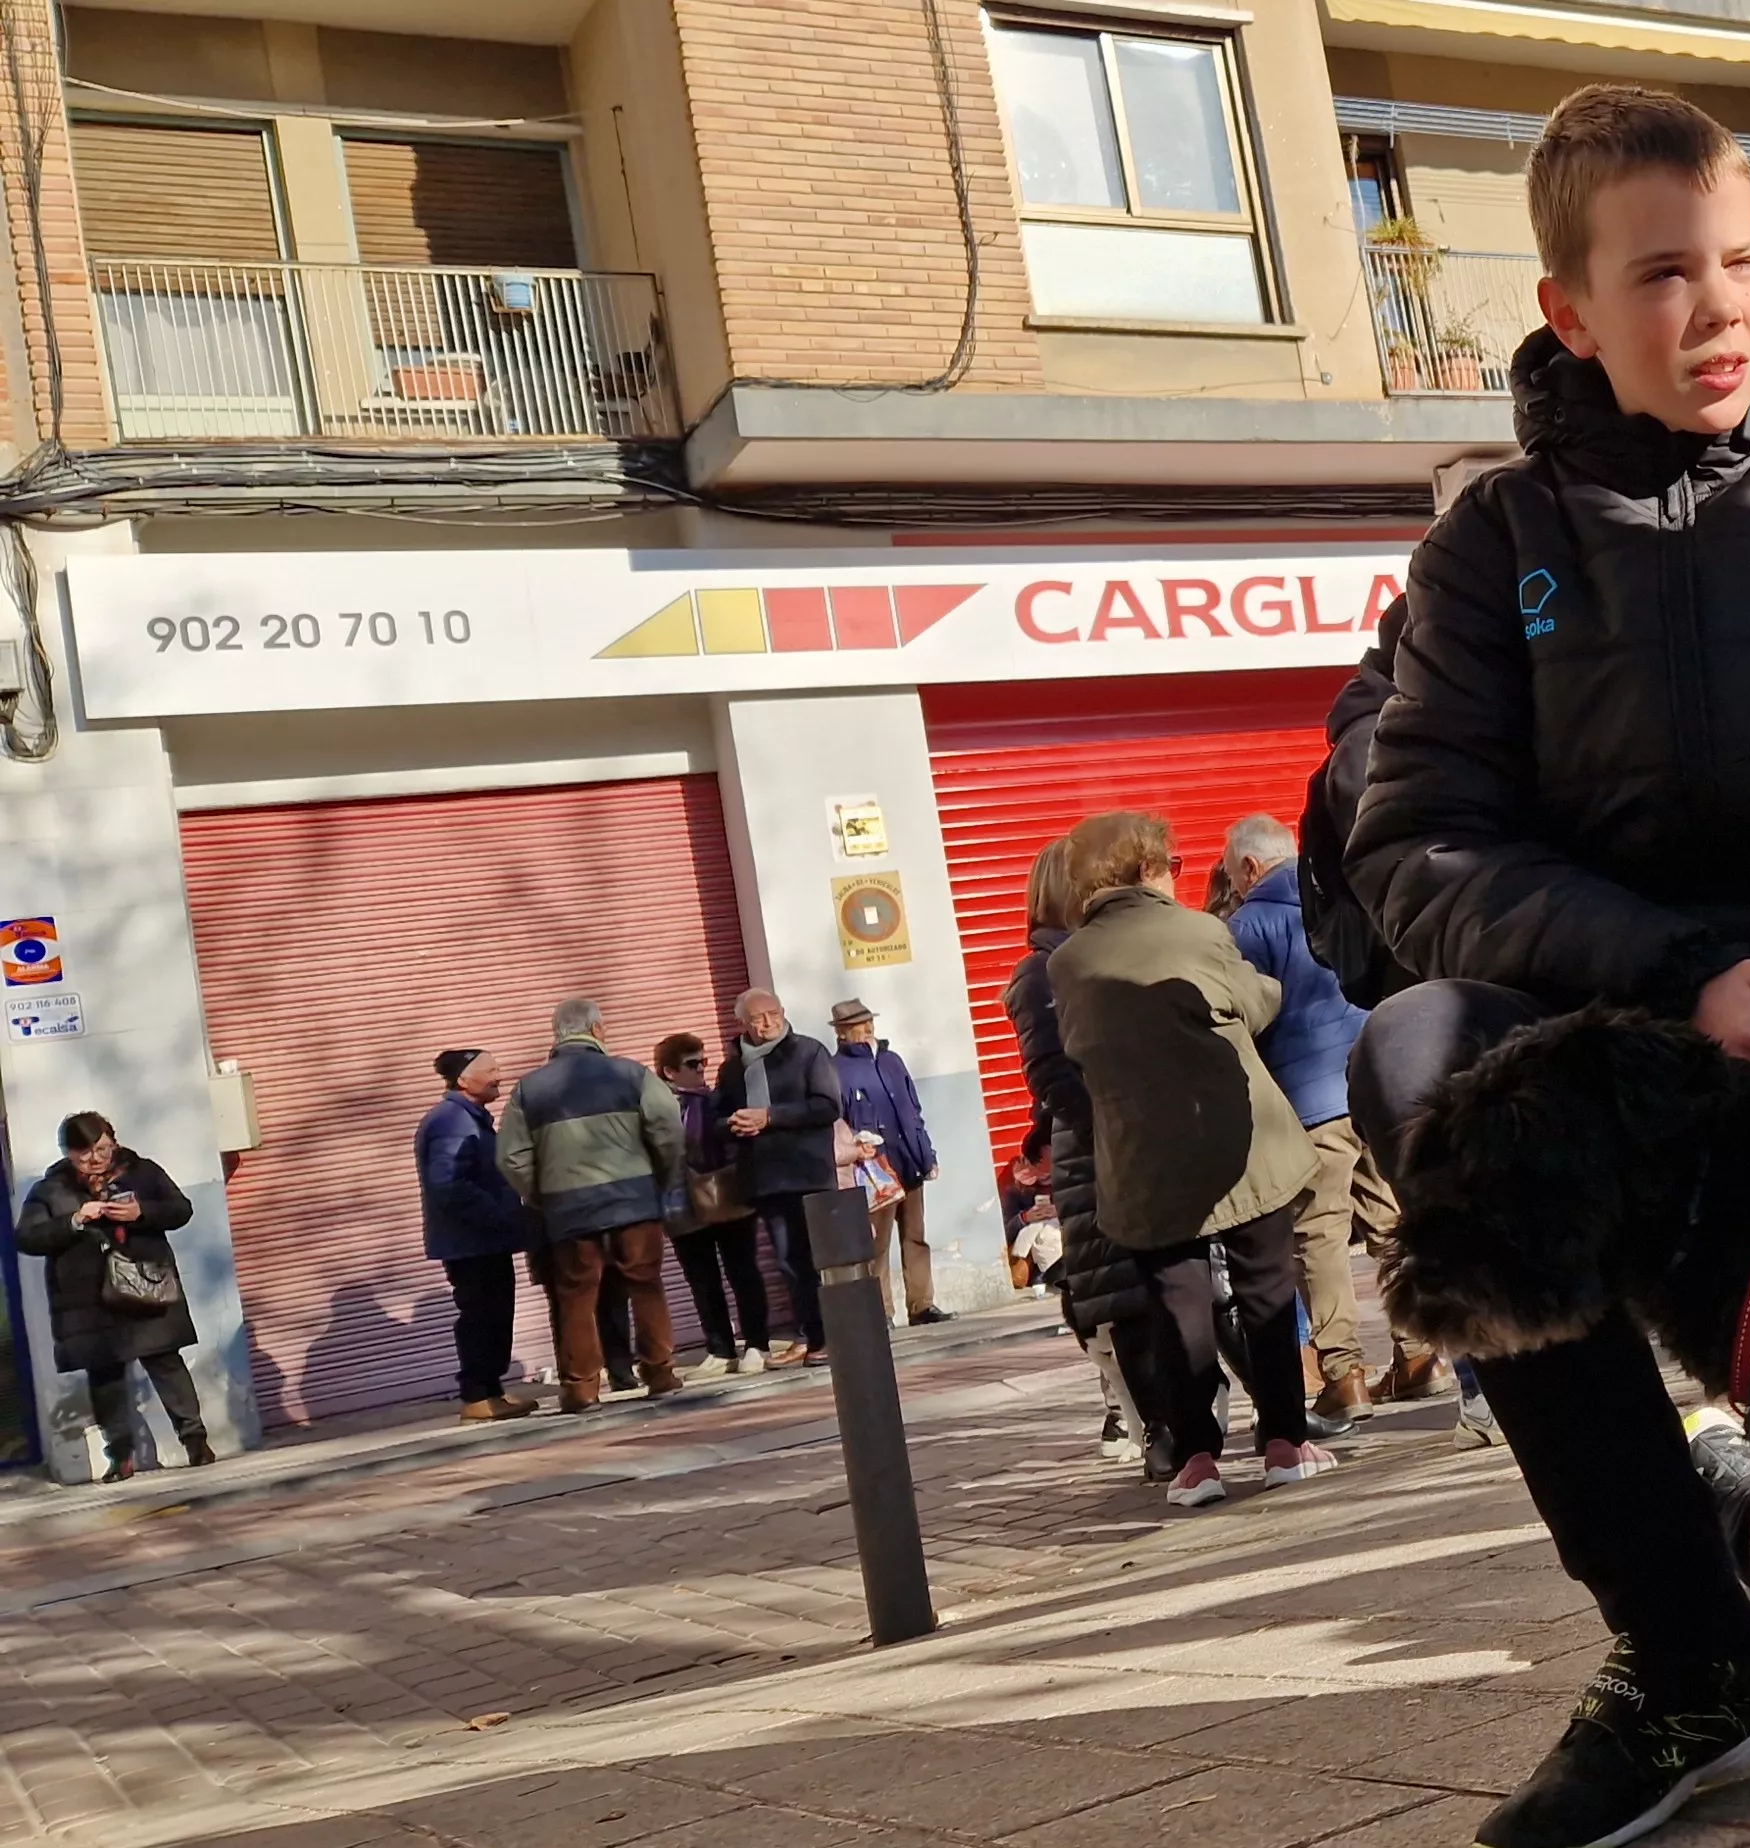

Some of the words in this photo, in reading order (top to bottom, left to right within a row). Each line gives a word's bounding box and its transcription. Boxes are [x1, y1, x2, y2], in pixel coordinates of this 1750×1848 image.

[146, 615, 243, 653] 902
[259, 613, 321, 649] 20
[338, 611, 397, 647] 70
[418, 609, 471, 645] 10
[9, 1001, 32, 1012] 902
